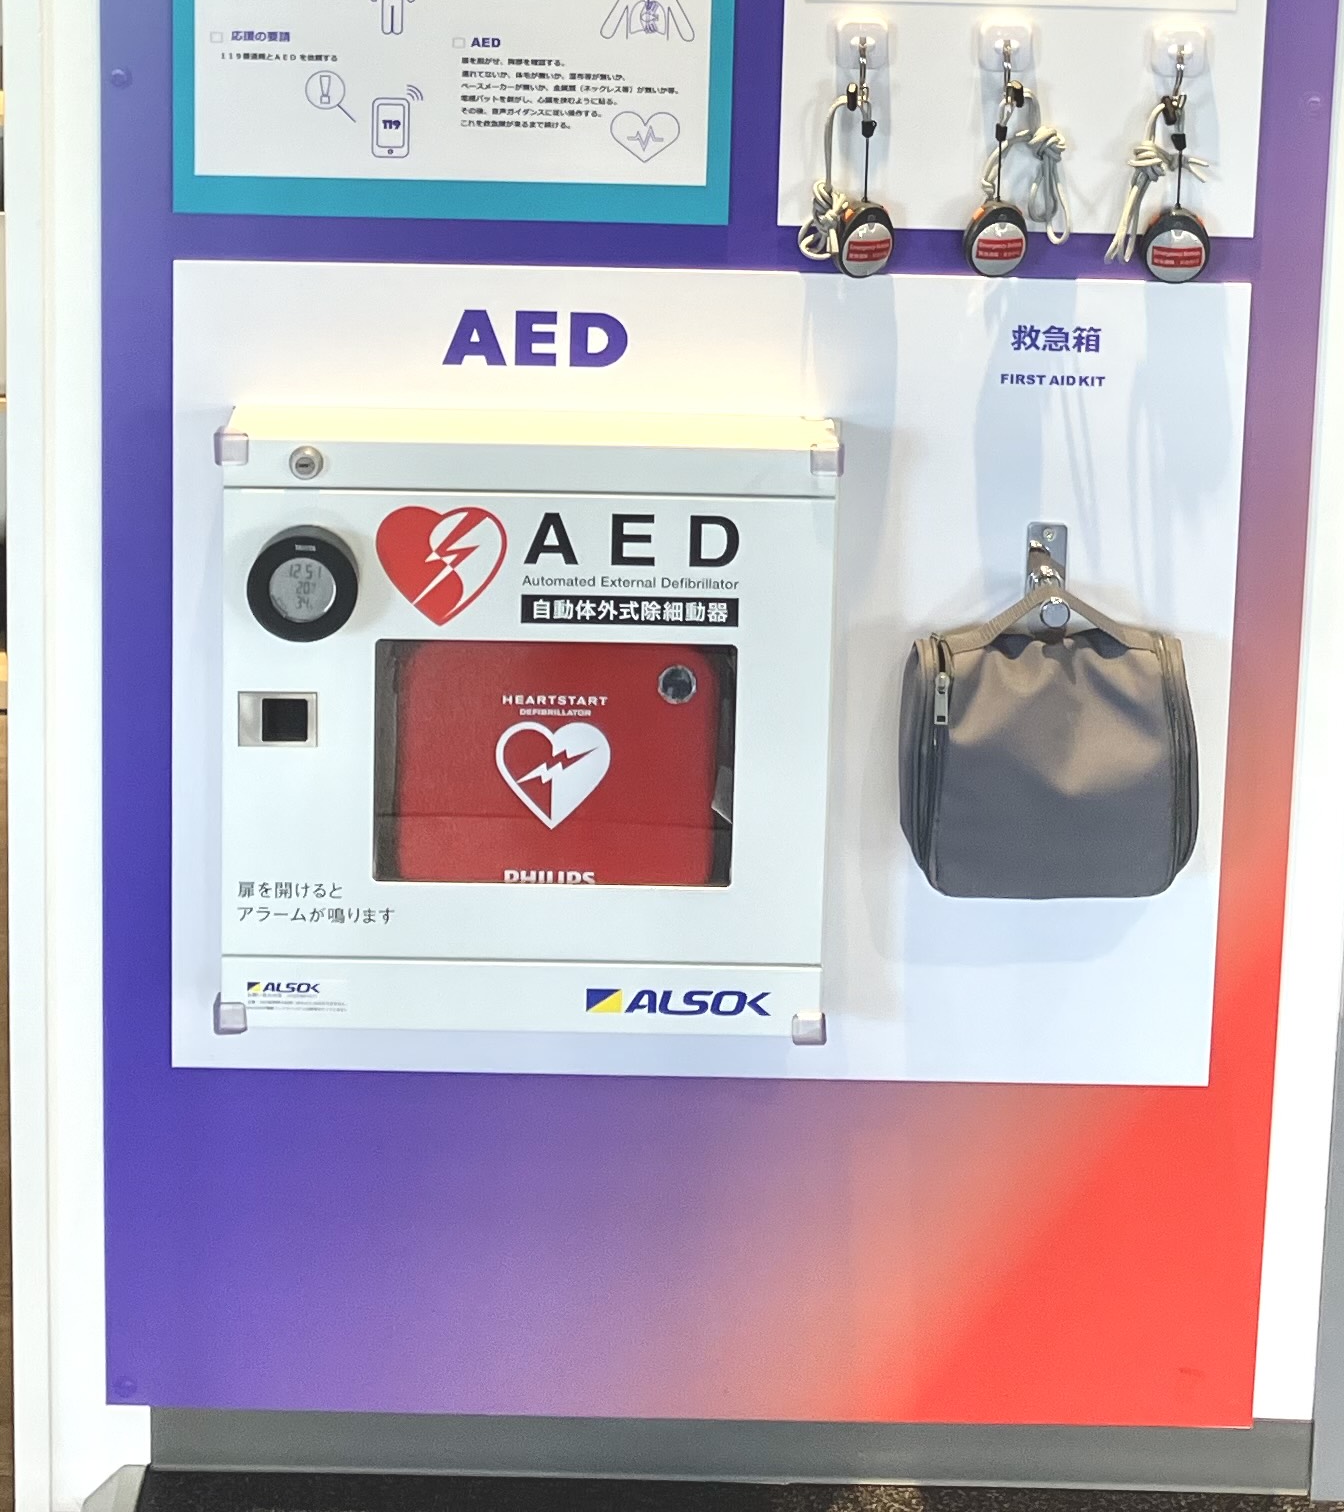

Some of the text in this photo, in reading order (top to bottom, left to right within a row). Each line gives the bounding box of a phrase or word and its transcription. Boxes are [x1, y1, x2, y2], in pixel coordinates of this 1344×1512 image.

[471, 38, 501, 48] AED
[442, 309, 629, 368] AED
[1011, 324, 1102, 354] 救急箱
[1000, 374, 1105, 387] FIRST AID KIT
[522, 575, 740, 590] Automated External Defibrillator
[531, 599, 729, 623] 自動体外式除細動器
[502, 694, 608, 707] HEARTSTART
[519, 708, 592, 717] DEFIBRILLATOR
[238, 880, 344, 900] 扉を開けると
[237, 906, 396, 926] アラームが鳴ります
[262, 980, 320, 994] ALSOK
[625, 989, 772, 1017] ALSOK
